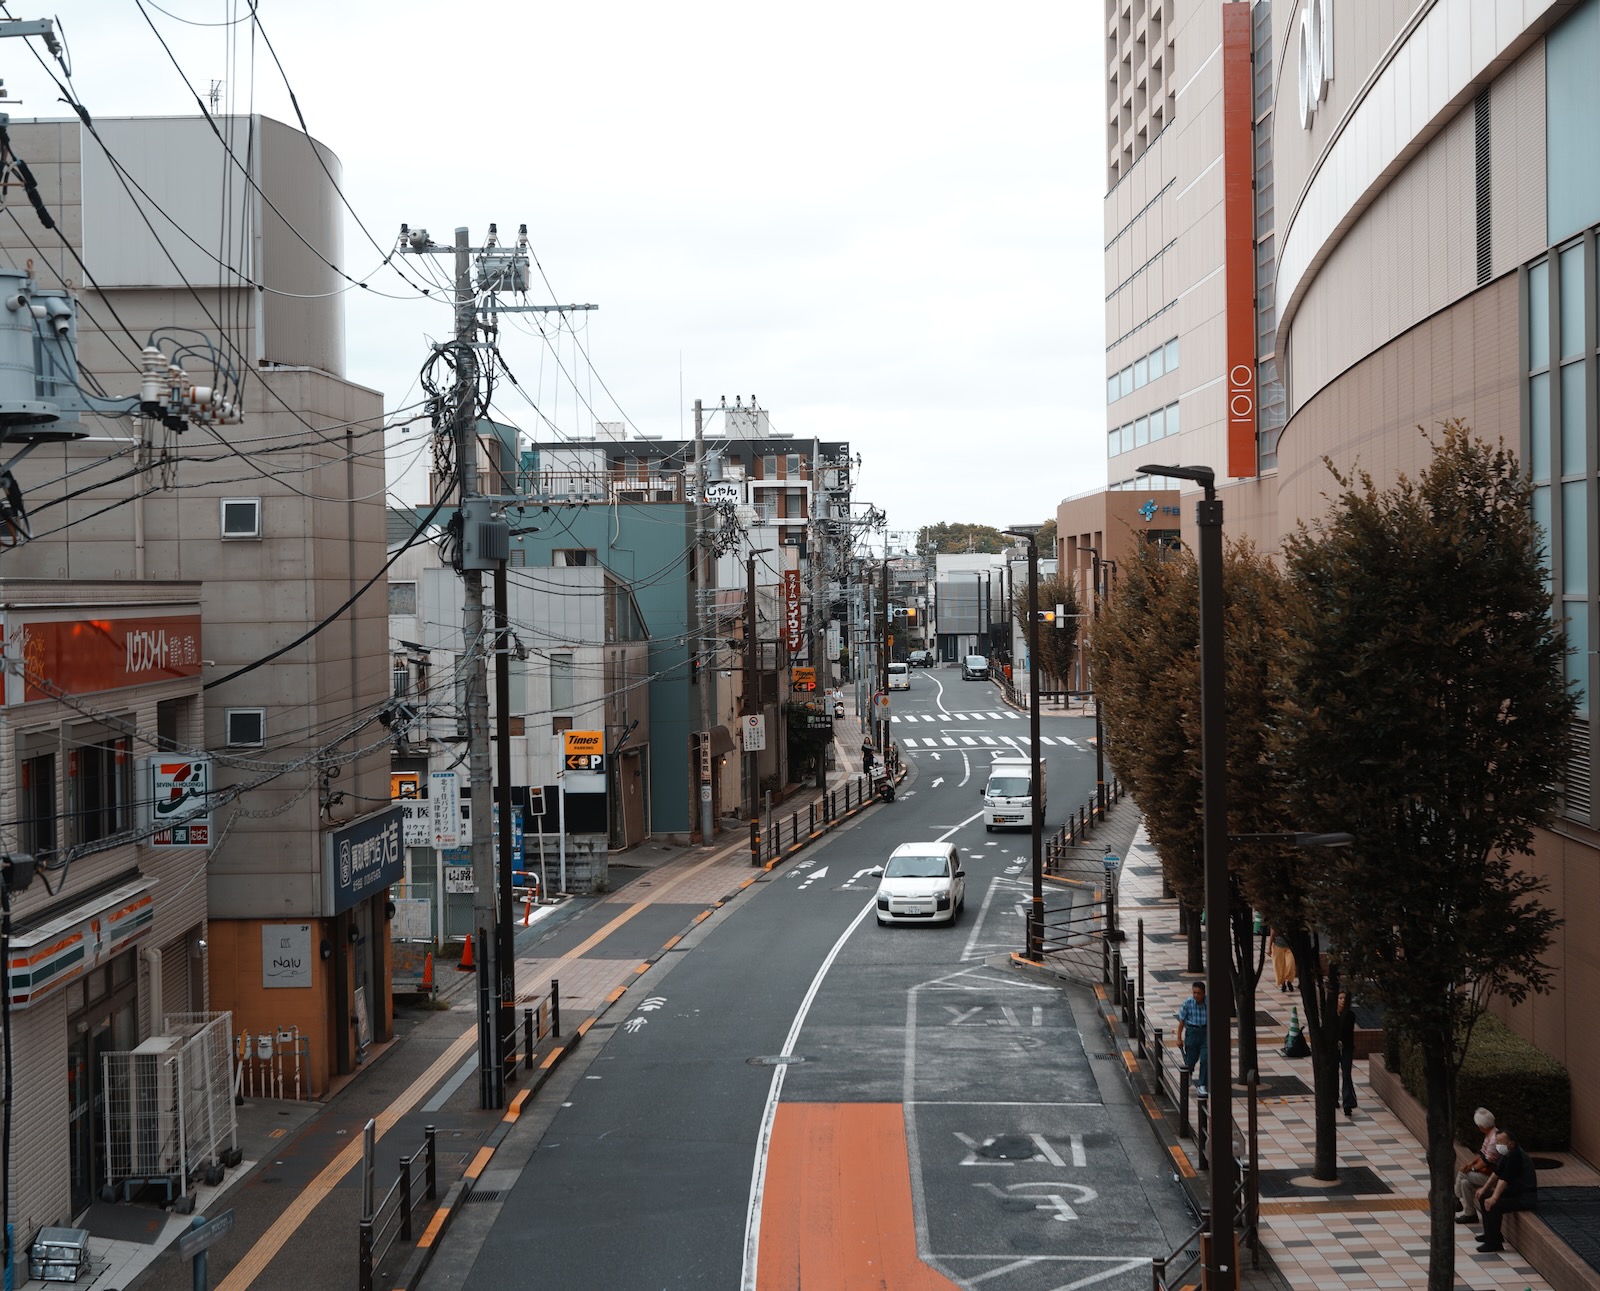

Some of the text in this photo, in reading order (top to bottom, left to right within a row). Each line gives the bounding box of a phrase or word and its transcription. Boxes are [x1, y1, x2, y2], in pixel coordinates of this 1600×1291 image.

[126, 629, 168, 673] ハウスメイト
[569, 735, 599, 744] Times
[591, 755, 602, 769] P
[175, 829, 187, 841] 酒
[273, 956, 301, 969] Nalu
